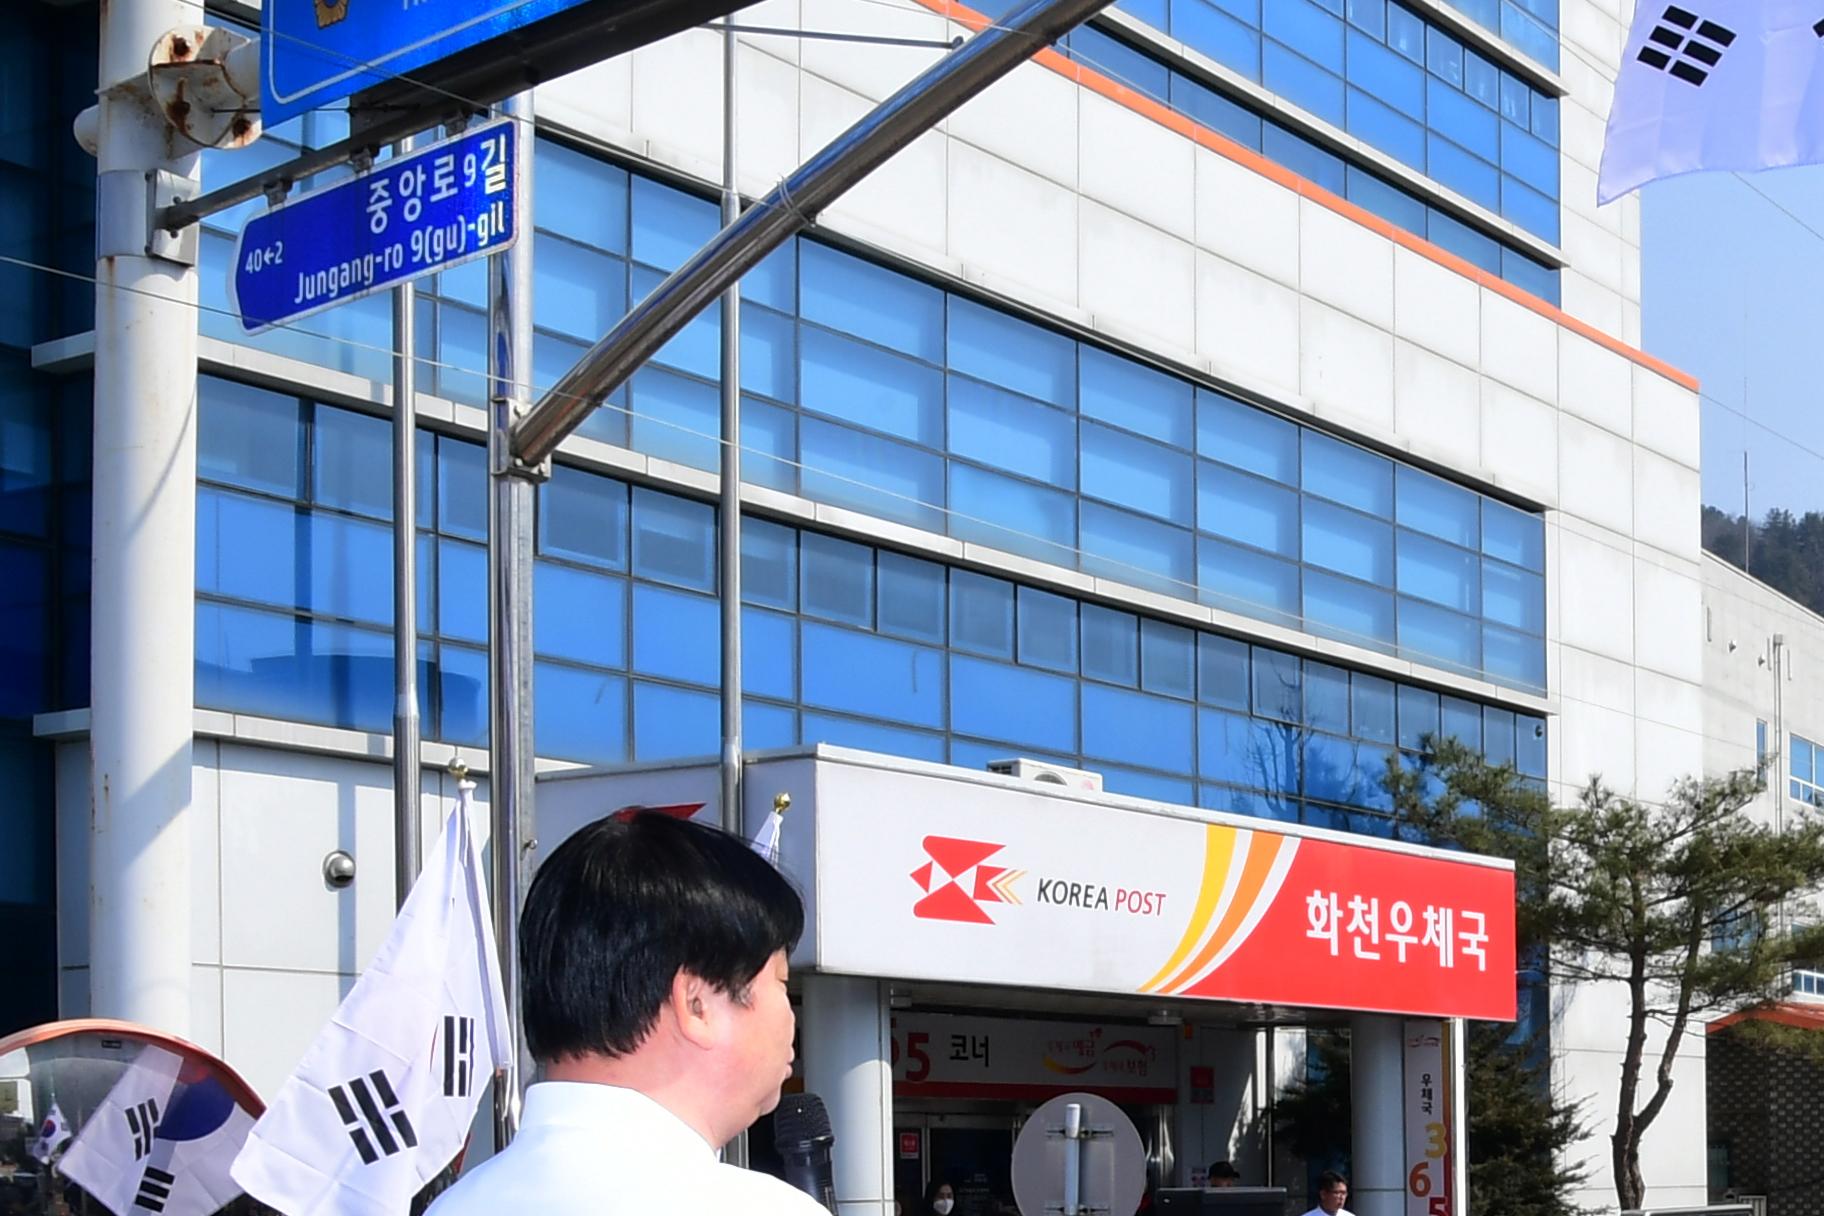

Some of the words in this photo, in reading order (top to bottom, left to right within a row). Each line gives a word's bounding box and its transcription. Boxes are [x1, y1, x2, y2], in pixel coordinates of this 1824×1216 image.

[366, 134, 506, 234] 중앙로9길
[294, 243, 403, 304] Jungang-ro
[410, 201, 506, 263] 9(gu)-gil
[1037, 878, 1109, 911] KOREA
[1114, 888, 1167, 917] POST
[1306, 889, 1491, 973] 화천우체국
[949, 1033, 990, 1068] 코너
[1420, 1073, 1434, 1116] 우체국
